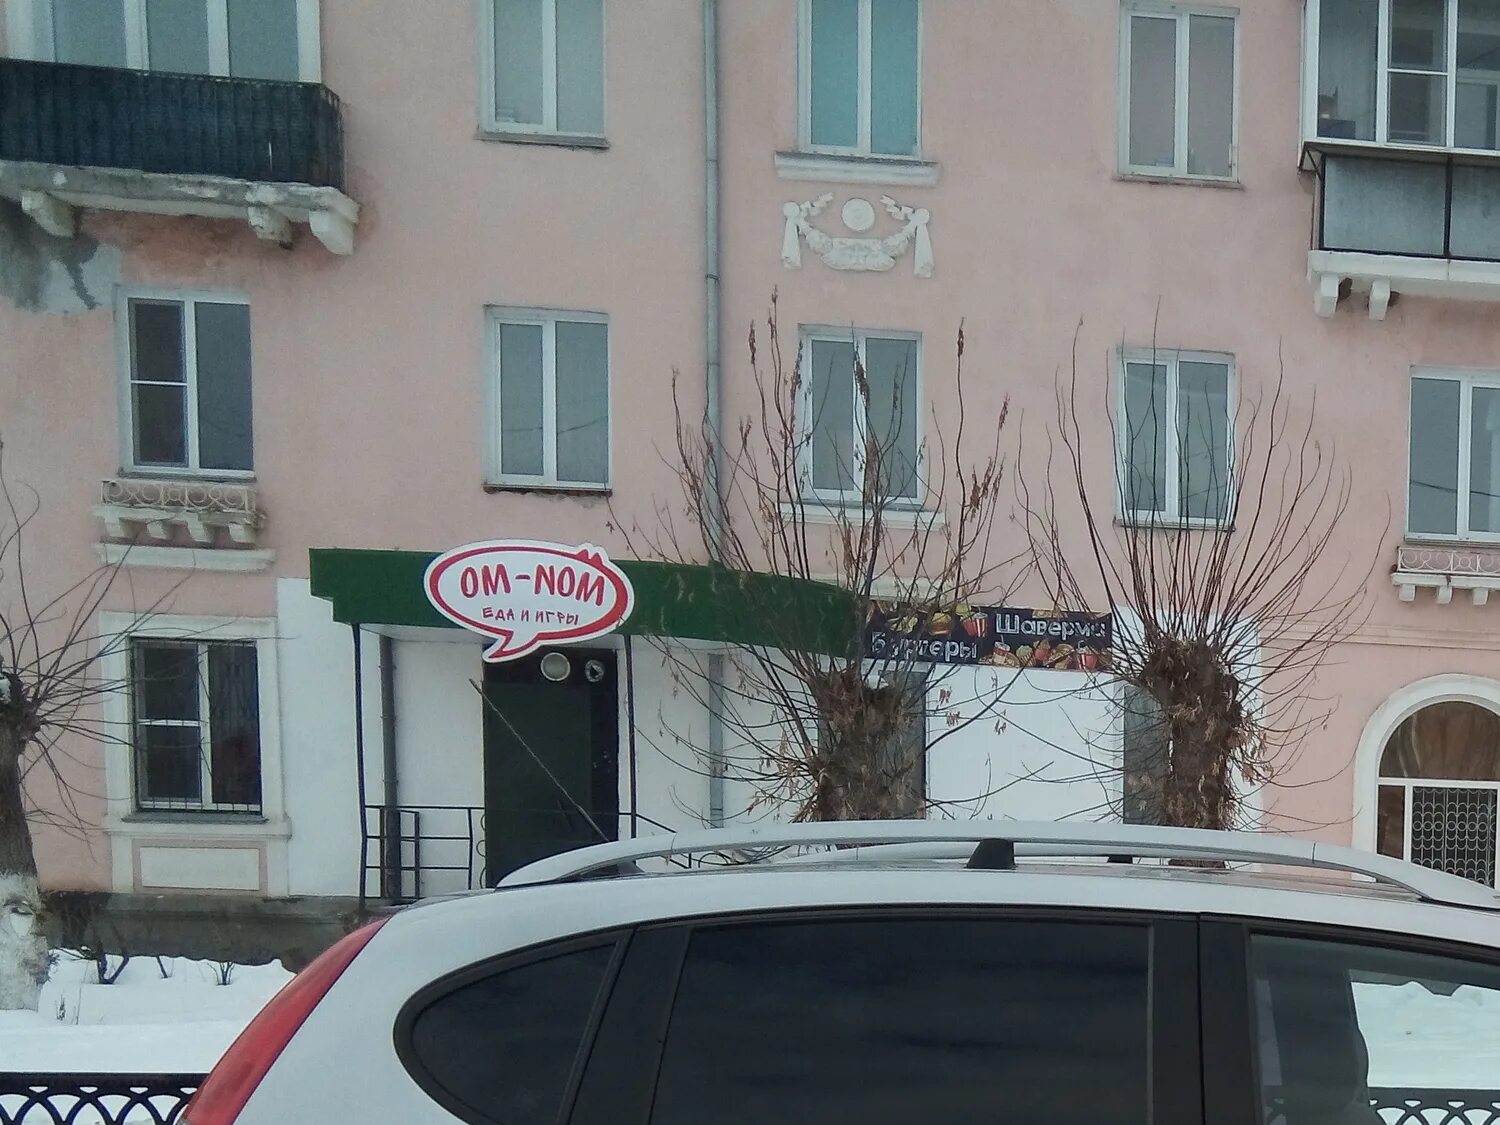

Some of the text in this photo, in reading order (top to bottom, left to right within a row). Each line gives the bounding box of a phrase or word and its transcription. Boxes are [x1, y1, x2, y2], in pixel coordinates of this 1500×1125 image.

[460, 563, 605, 606] OM-NOM
[482, 607, 579, 625] ЕДА И ИГРЫ
